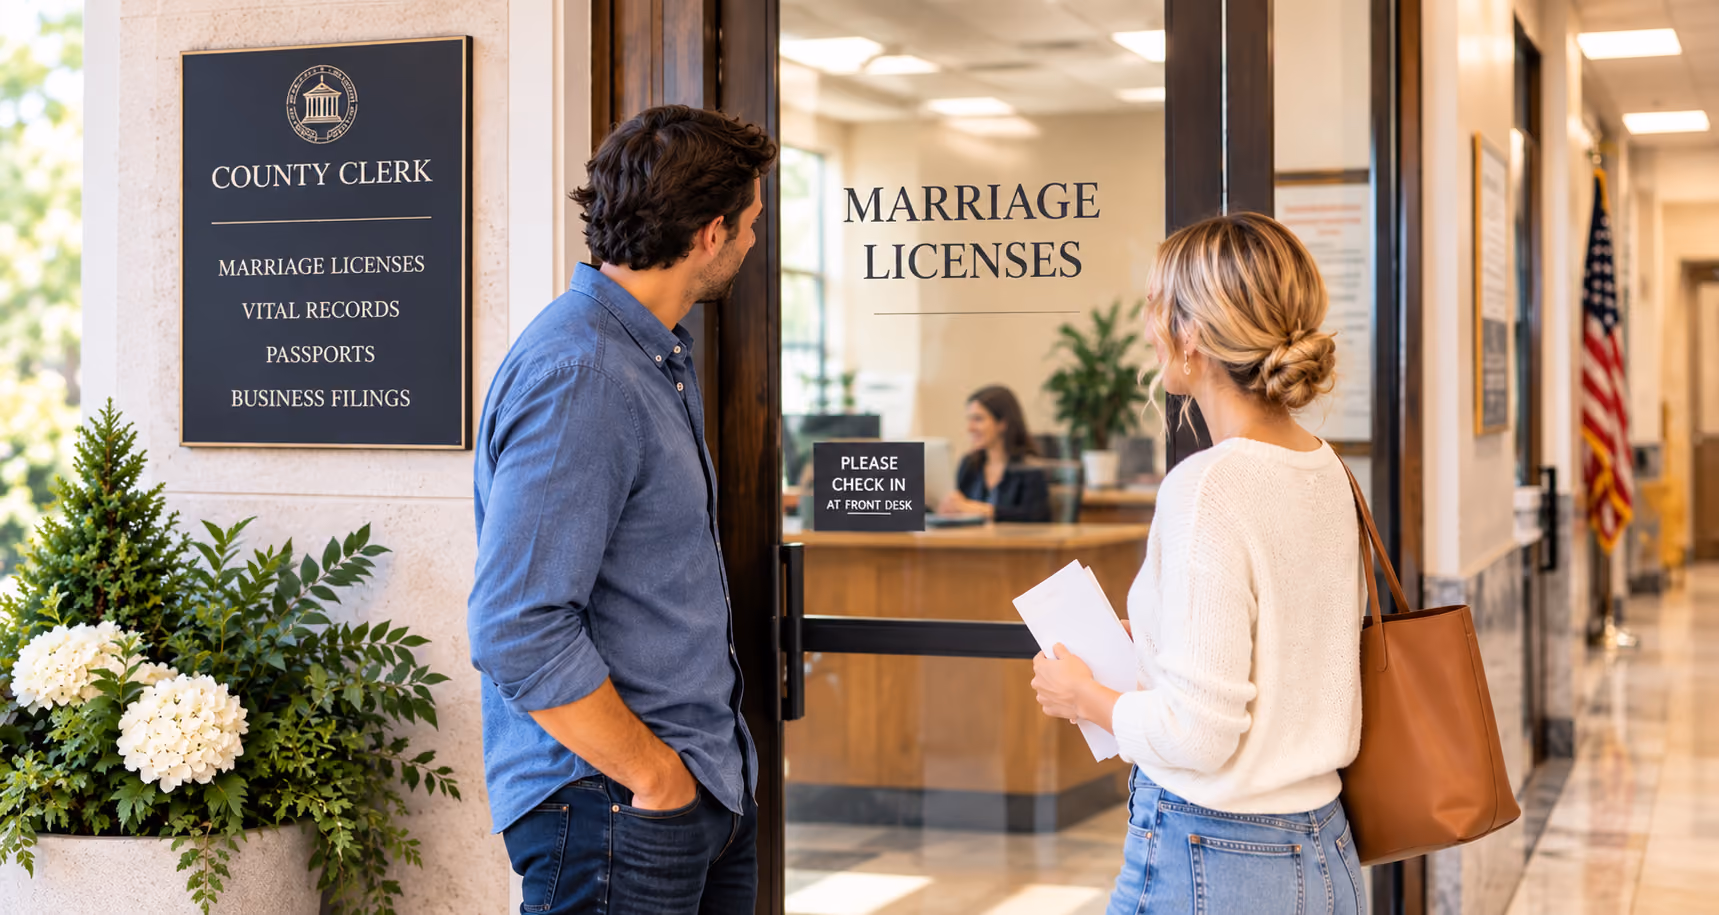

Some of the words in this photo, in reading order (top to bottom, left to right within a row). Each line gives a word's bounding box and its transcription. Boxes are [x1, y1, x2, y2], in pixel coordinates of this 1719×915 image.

[211, 162, 331, 190] COUNTY
[338, 158, 434, 185] CLERK
[843, 181, 1101, 223] MARRIAGE
[218, 257, 325, 277] MARRIAGE
[330, 254, 425, 275] LICENSES
[863, 240, 1082, 280] LICENSES
[241, 301, 301, 320] VITAL
[305, 300, 400, 319] RECORDS
[265, 345, 376, 364] PASSPORTS
[230, 389, 325, 408] BUSINESS
[330, 388, 411, 408] FILINGS
[840, 455, 899, 471] PLEASE
[831, 477, 885, 492] CHECK
[889, 477, 906, 492] IN
[826, 499, 842, 510] AT
[844, 499, 882, 511] FRONT
[884, 499, 913, 511] DESK
